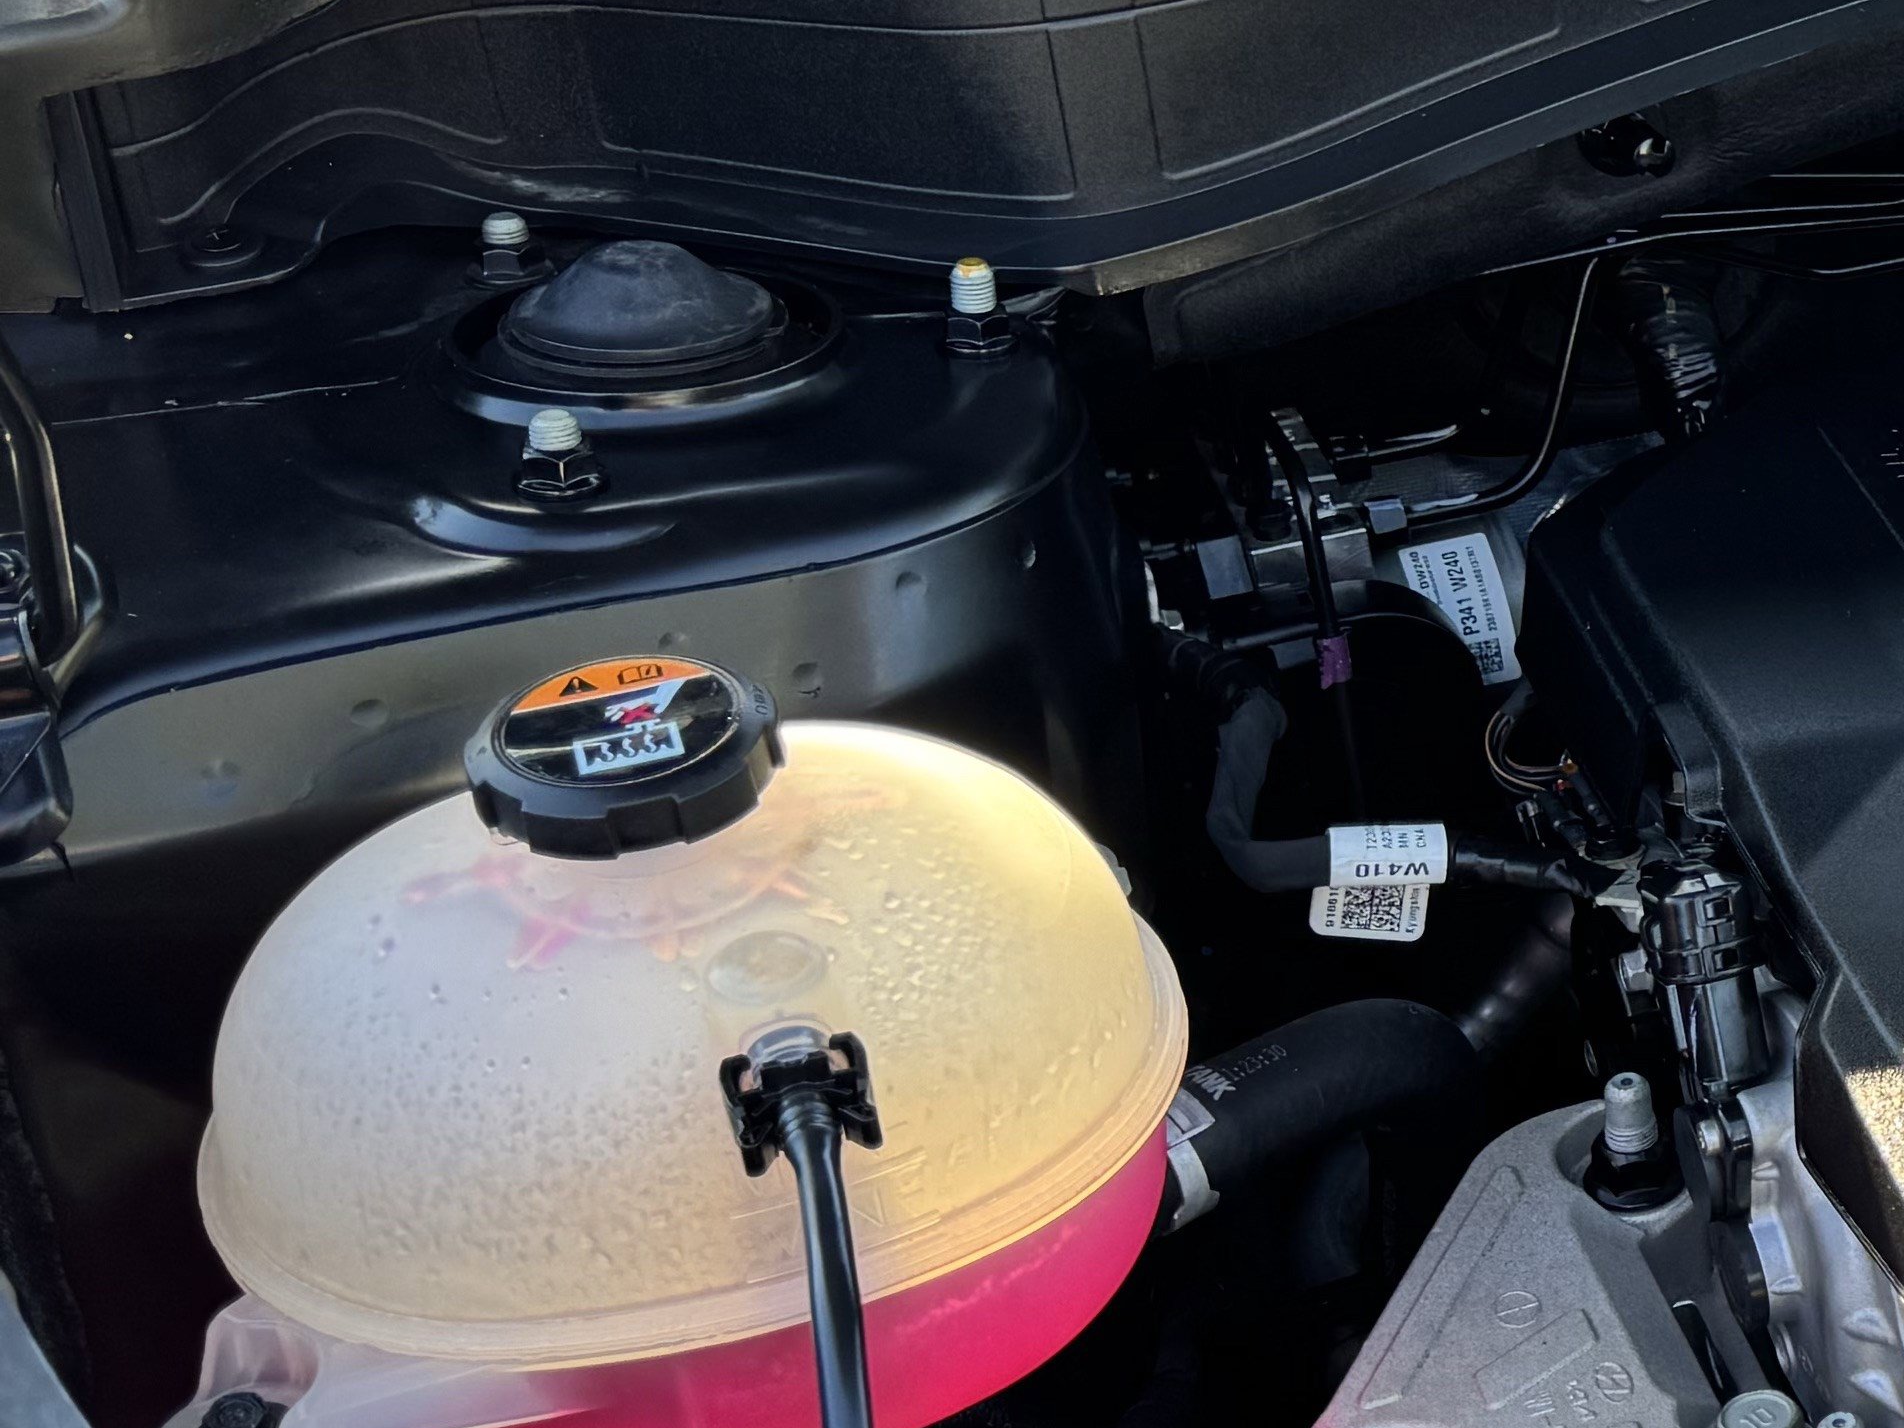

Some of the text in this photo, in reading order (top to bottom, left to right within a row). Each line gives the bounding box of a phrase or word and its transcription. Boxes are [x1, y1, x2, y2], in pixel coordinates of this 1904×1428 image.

[1442, 550, 1468, 594] W240
[1459, 597, 1482, 637] P341
[1355, 862, 1429, 877] W410
